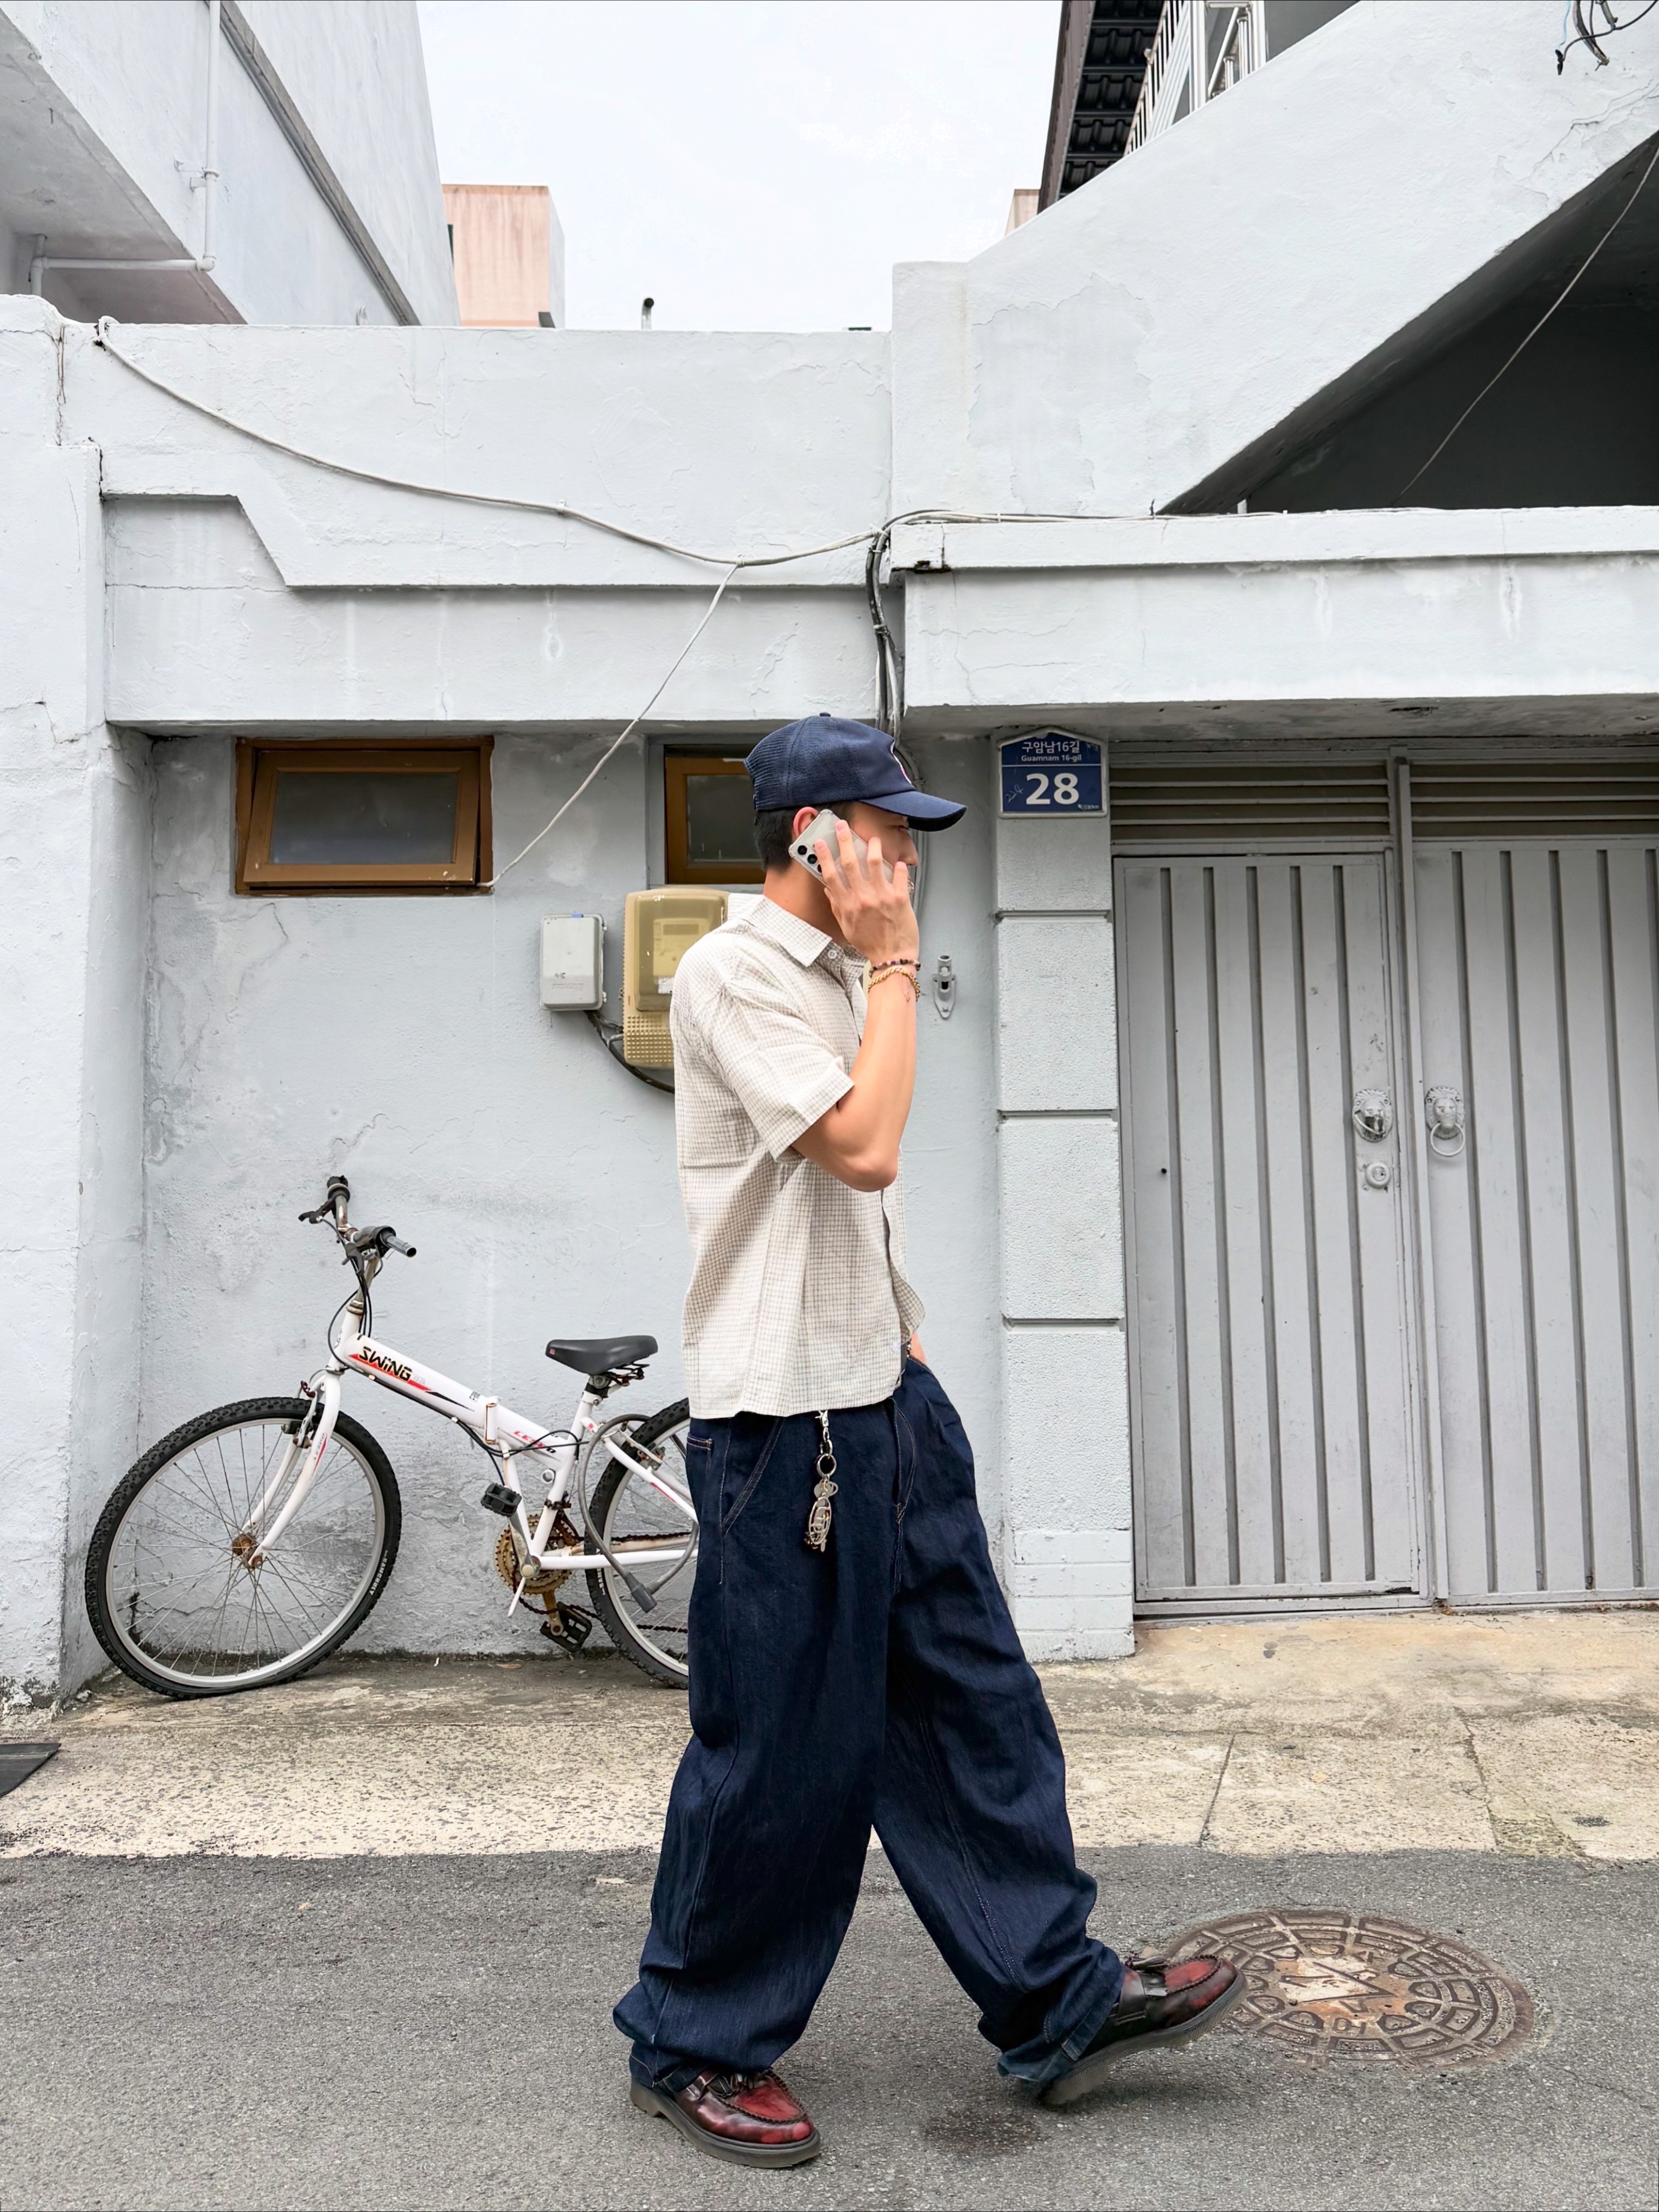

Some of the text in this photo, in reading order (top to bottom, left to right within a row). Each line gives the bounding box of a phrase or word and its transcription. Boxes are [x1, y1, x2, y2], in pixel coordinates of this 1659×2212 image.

[1022, 740, 1080, 754] 구암남16길
[1062, 754, 1082, 763] 16-gil
[1026, 773, 1080, 805] 28
